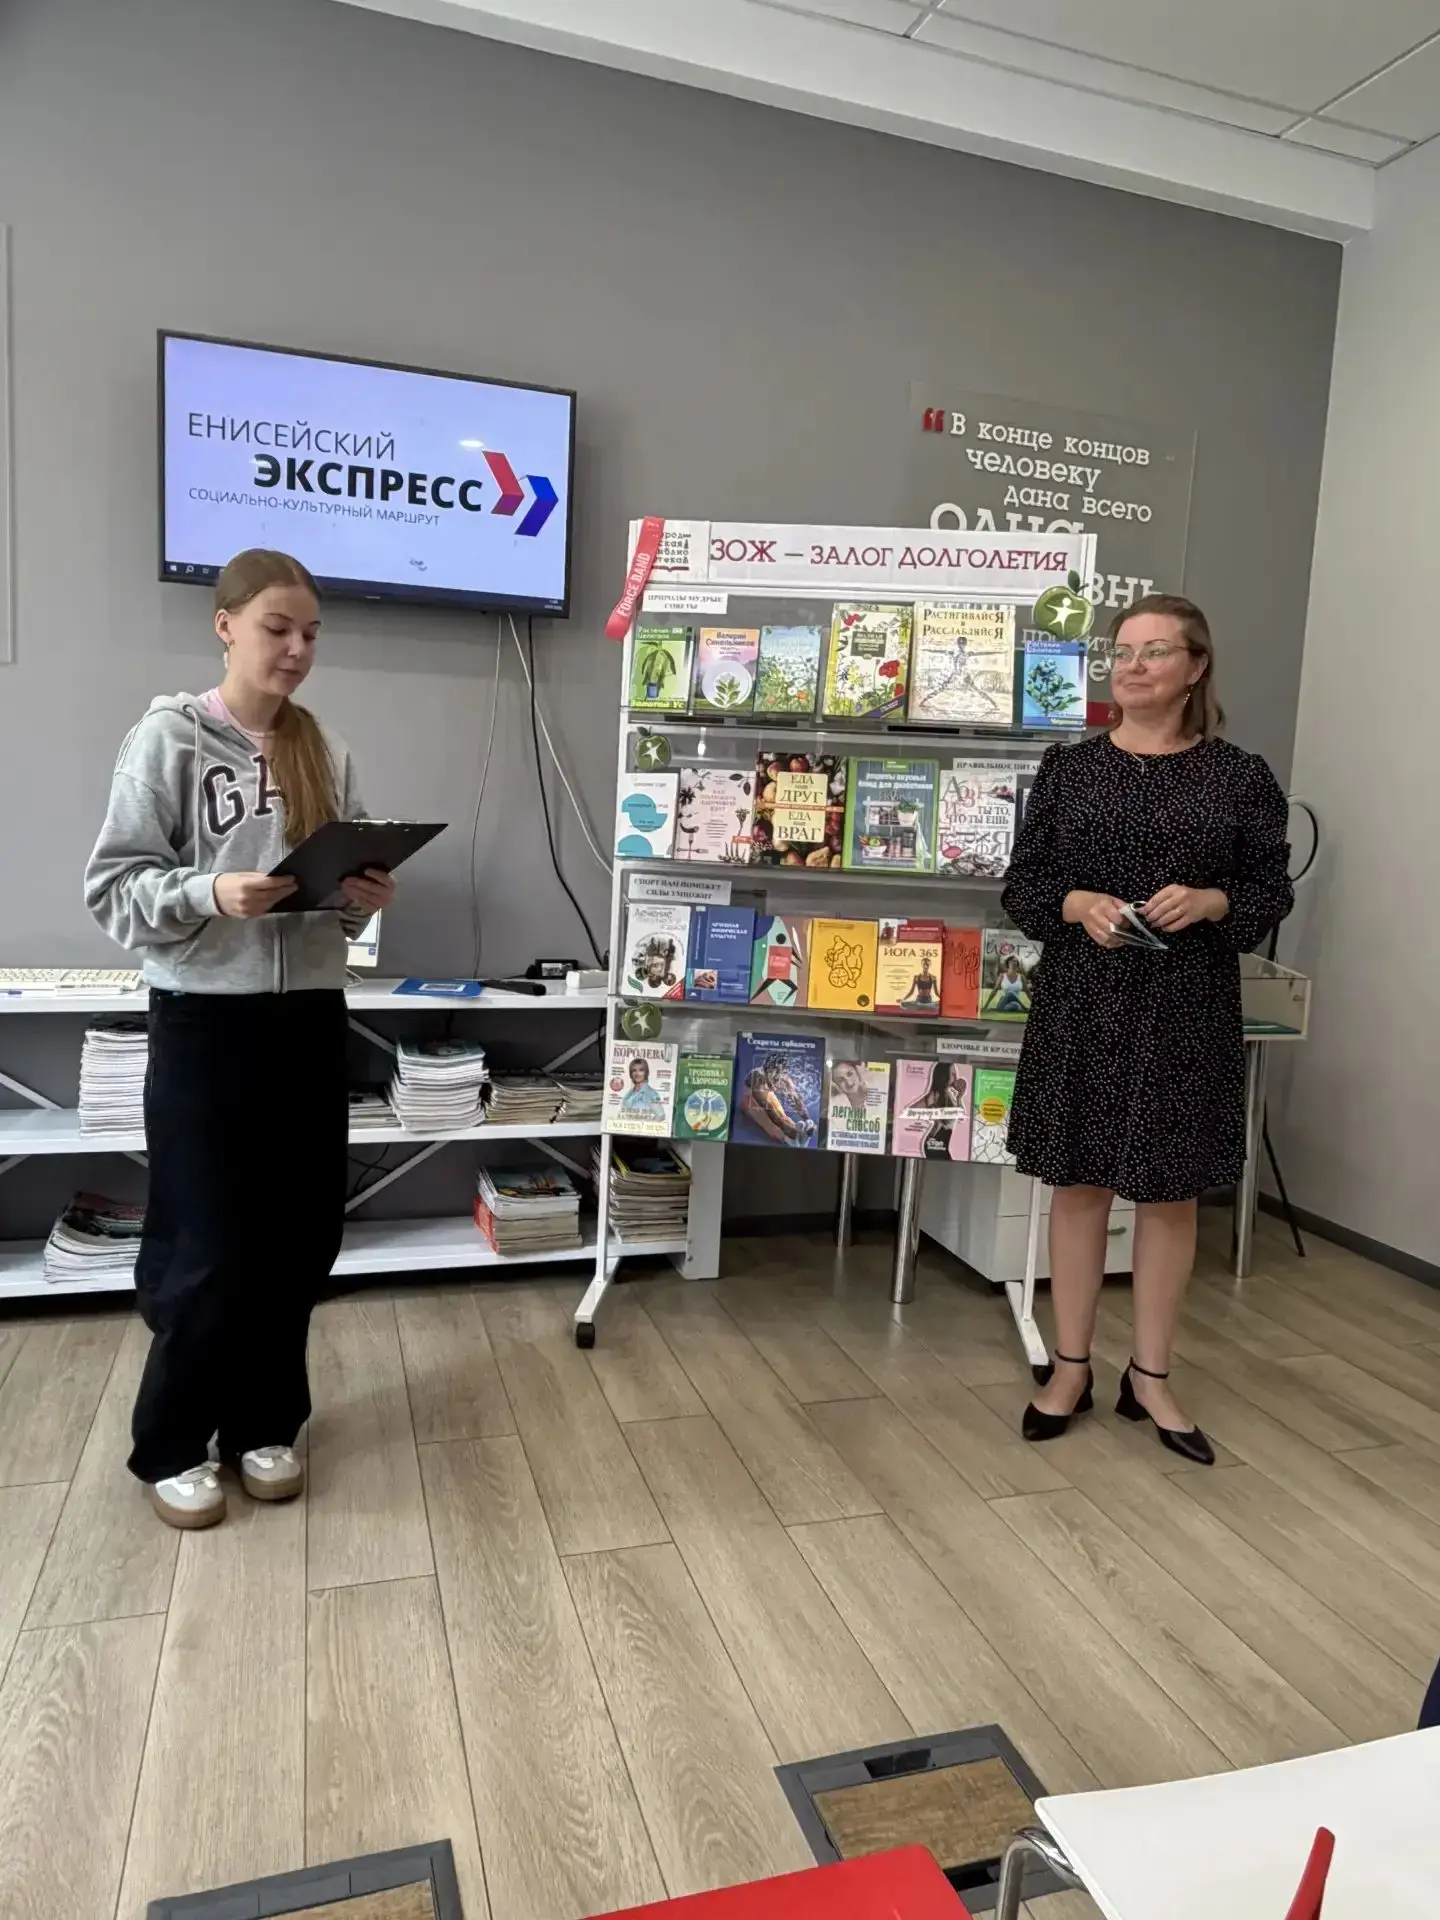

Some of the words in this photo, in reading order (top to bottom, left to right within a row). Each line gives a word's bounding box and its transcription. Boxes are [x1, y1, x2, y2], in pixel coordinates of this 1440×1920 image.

[188, 412, 395, 461] ЕНИСЕЙСКИЙ
[978, 421, 1052, 450] конце
[1064, 436, 1150, 465] концов
[254, 454, 482, 512] ЭКСПРЕСС
[966, 449, 1101, 492] человеку
[189, 487, 373, 519] СОЦИАЛЬНО-КУЛЬТУРНЫЙ
[376, 509, 441, 526] МАРШРУТ
[1003, 486, 1070, 511] дана
[1082, 496, 1151, 522] всего
[710, 539, 777, 563] ЗОЖ
[811, 545, 892, 567] ЗАЛОГ
[898, 547, 1067, 571] ДОЛГОЛЕТИЯ
[616, 582, 639, 617] FORCE
[630, 552, 651, 583] BAND
[202, 754, 286, 836] GA
[780, 789, 823, 803] ДРУГ
[791, 774, 814, 785] ЕДА
[777, 825, 822, 841] ВРАГ
[788, 810, 811, 821] ЕДА
[884, 946, 916, 957] ЙОГА
[919, 948, 938, 957] 365
